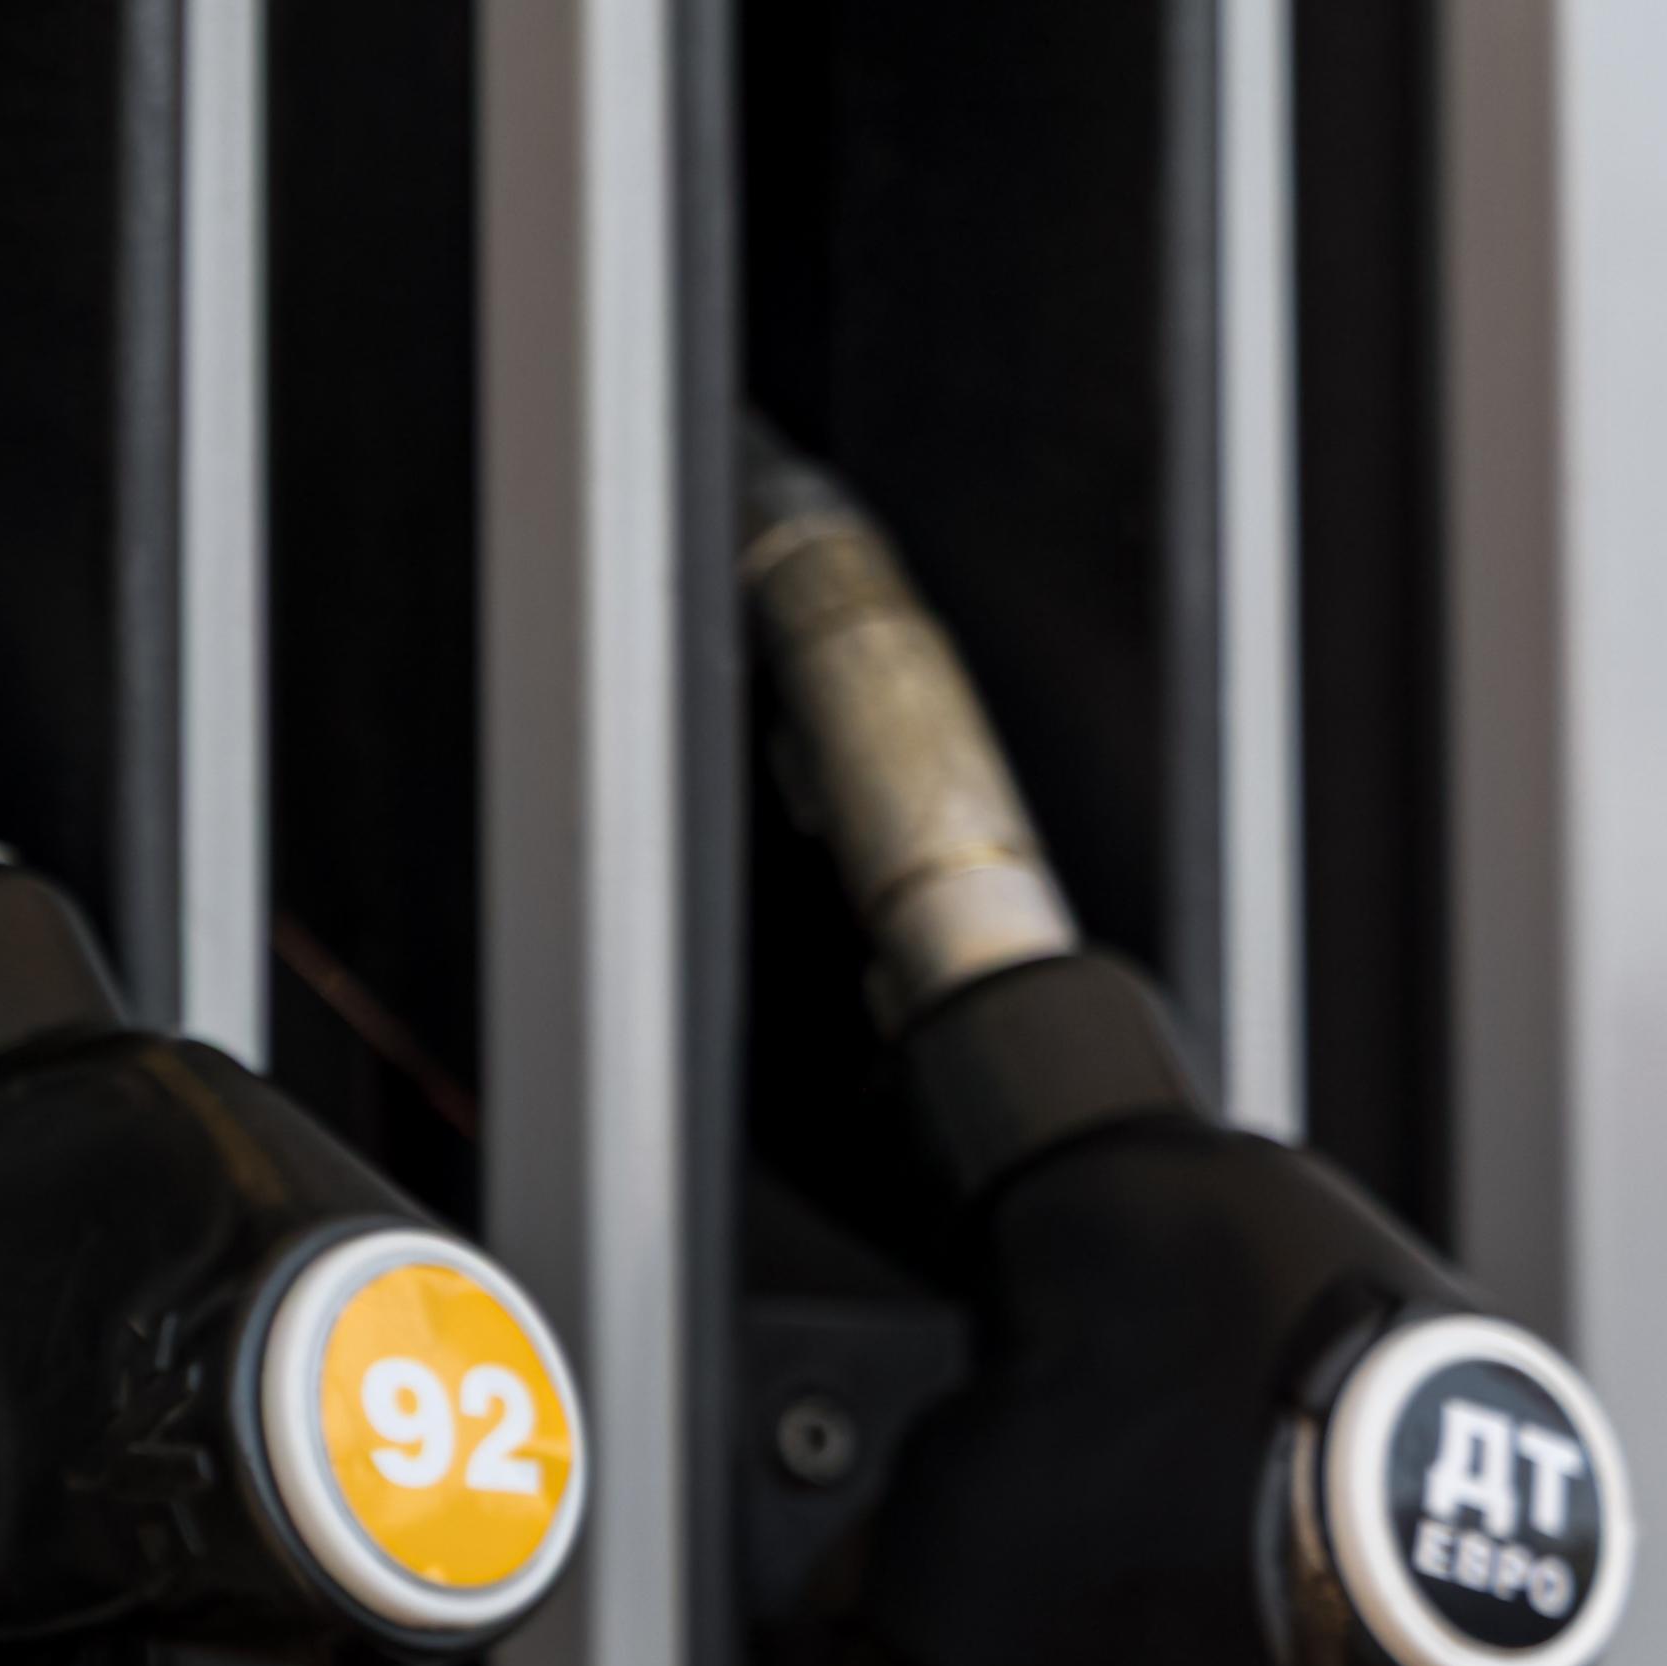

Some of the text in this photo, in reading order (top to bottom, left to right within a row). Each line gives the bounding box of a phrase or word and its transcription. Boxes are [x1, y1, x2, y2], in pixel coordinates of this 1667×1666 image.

[361, 1356, 541, 1495] 92
[1424, 1401, 1584, 1537] ДТ
[1415, 1520, 1574, 1619] ЕВРО
